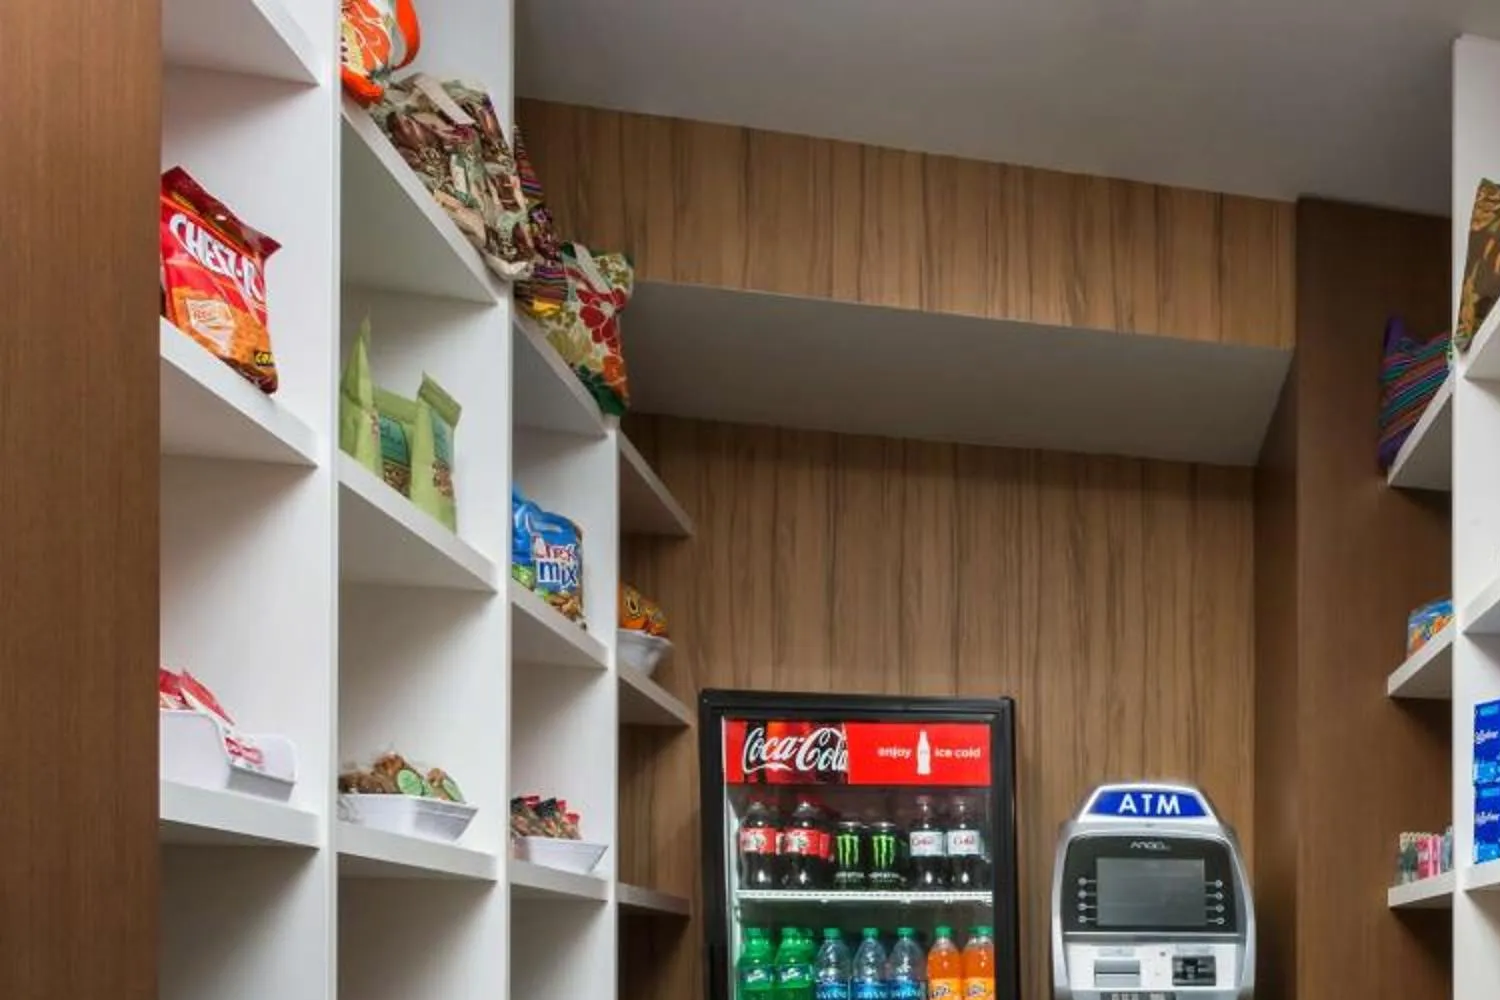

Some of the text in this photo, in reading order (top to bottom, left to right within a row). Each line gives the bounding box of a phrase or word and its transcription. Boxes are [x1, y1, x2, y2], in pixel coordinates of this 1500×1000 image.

[877, 747, 981, 760] enjoy ice cold
[1118, 793, 1181, 815] ATM
